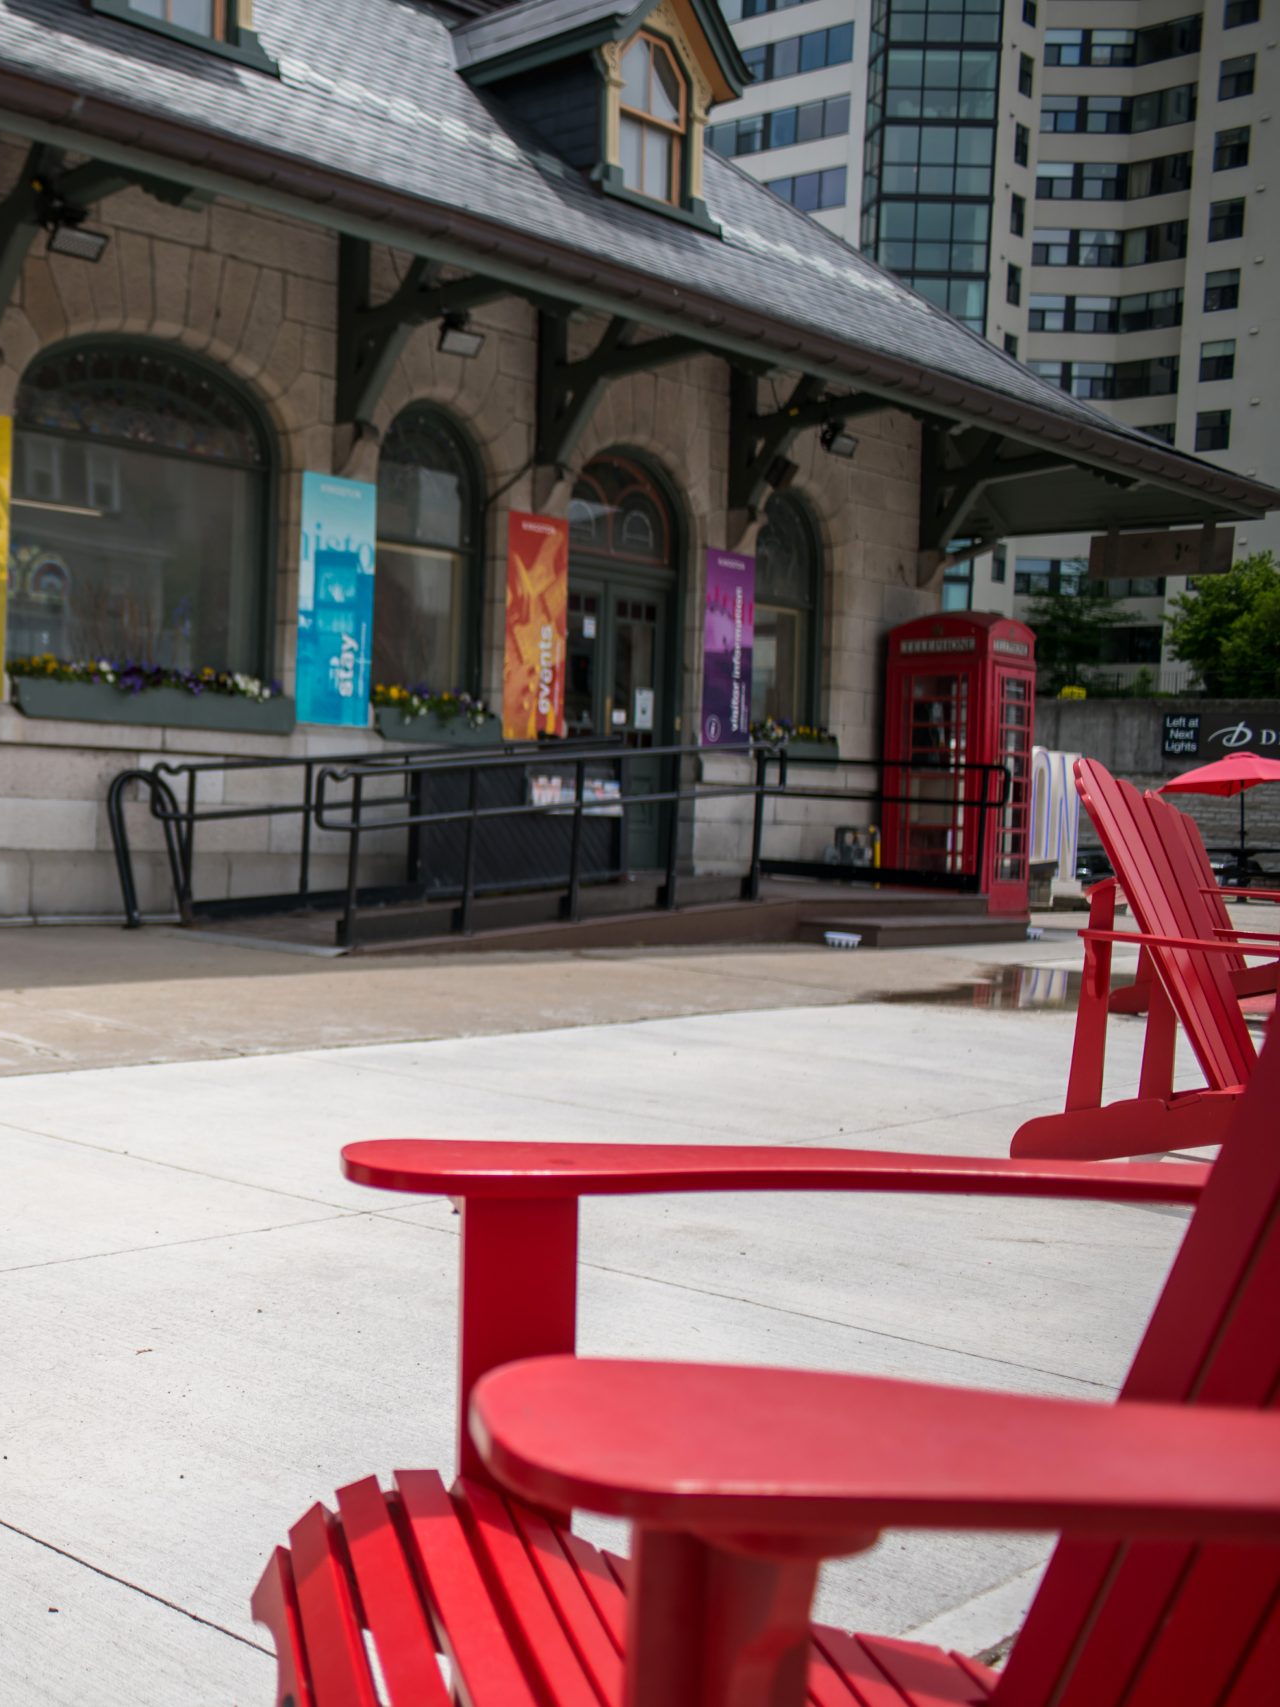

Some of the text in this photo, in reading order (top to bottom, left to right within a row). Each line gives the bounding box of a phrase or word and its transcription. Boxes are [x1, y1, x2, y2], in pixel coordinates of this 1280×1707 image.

[335, 632, 359, 698] stay
[538, 624, 554, 715] events
[1166, 716, 1199, 728] Left at
[1169, 728, 1195, 740] Next
[1260, 728, 1280, 745] D
[1165, 740, 1197, 753] Lights
